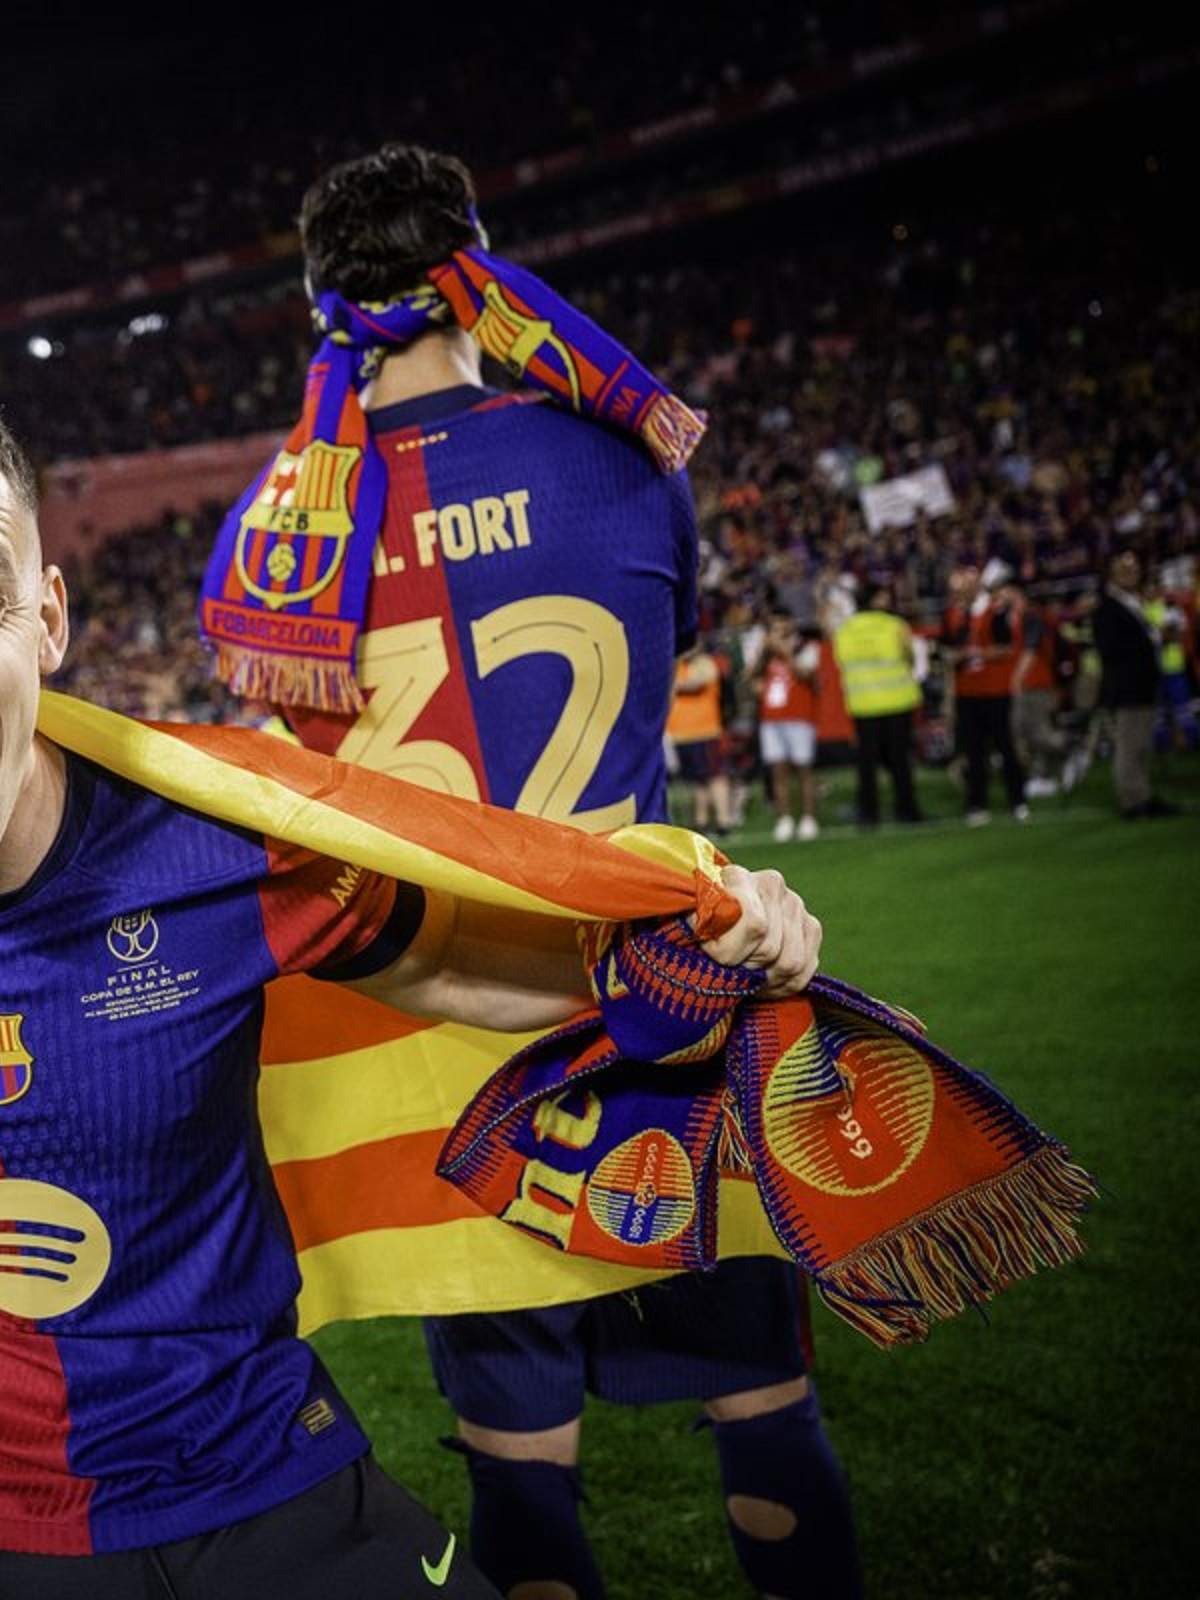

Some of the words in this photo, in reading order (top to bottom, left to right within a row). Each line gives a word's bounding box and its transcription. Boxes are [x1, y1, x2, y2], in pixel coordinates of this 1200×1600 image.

[412, 489, 531, 568] FORT
[336, 594, 637, 833] 32
[81, 990, 113, 1003] COPA
[177, 969, 199, 982] REY
[107, 965, 171, 986] FINAL
